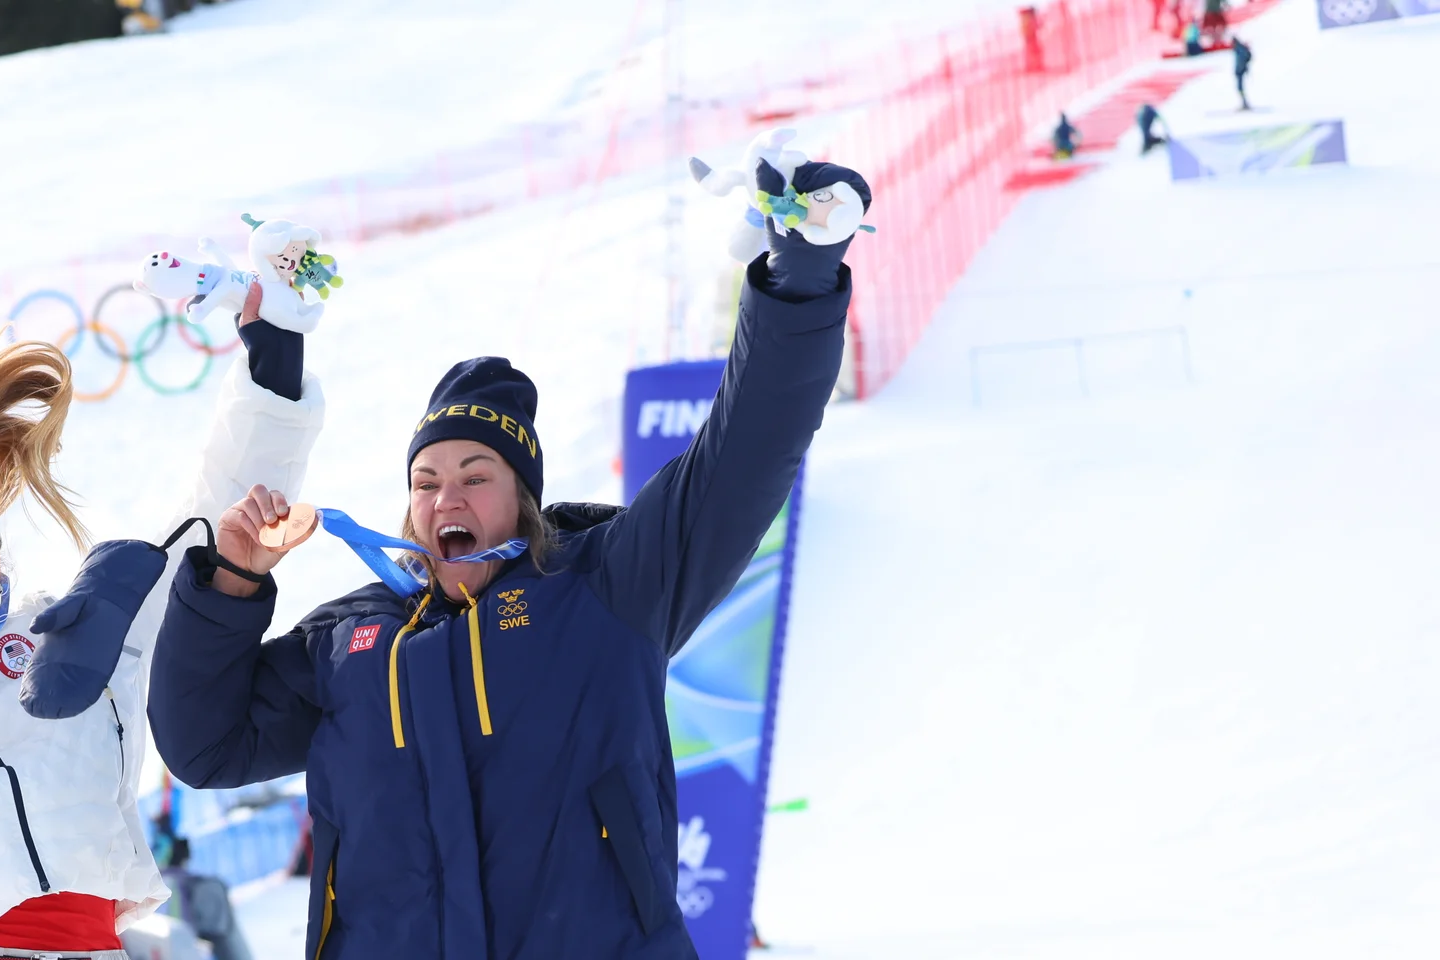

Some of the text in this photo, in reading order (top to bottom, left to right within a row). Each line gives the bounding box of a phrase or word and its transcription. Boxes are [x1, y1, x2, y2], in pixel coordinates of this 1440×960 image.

[638, 399, 713, 438] FIN
[413, 404, 537, 459] WEDEN
[499, 615, 530, 630] SWE
[355, 628, 375, 639] UNI
[352, 637, 373, 650] QLO
